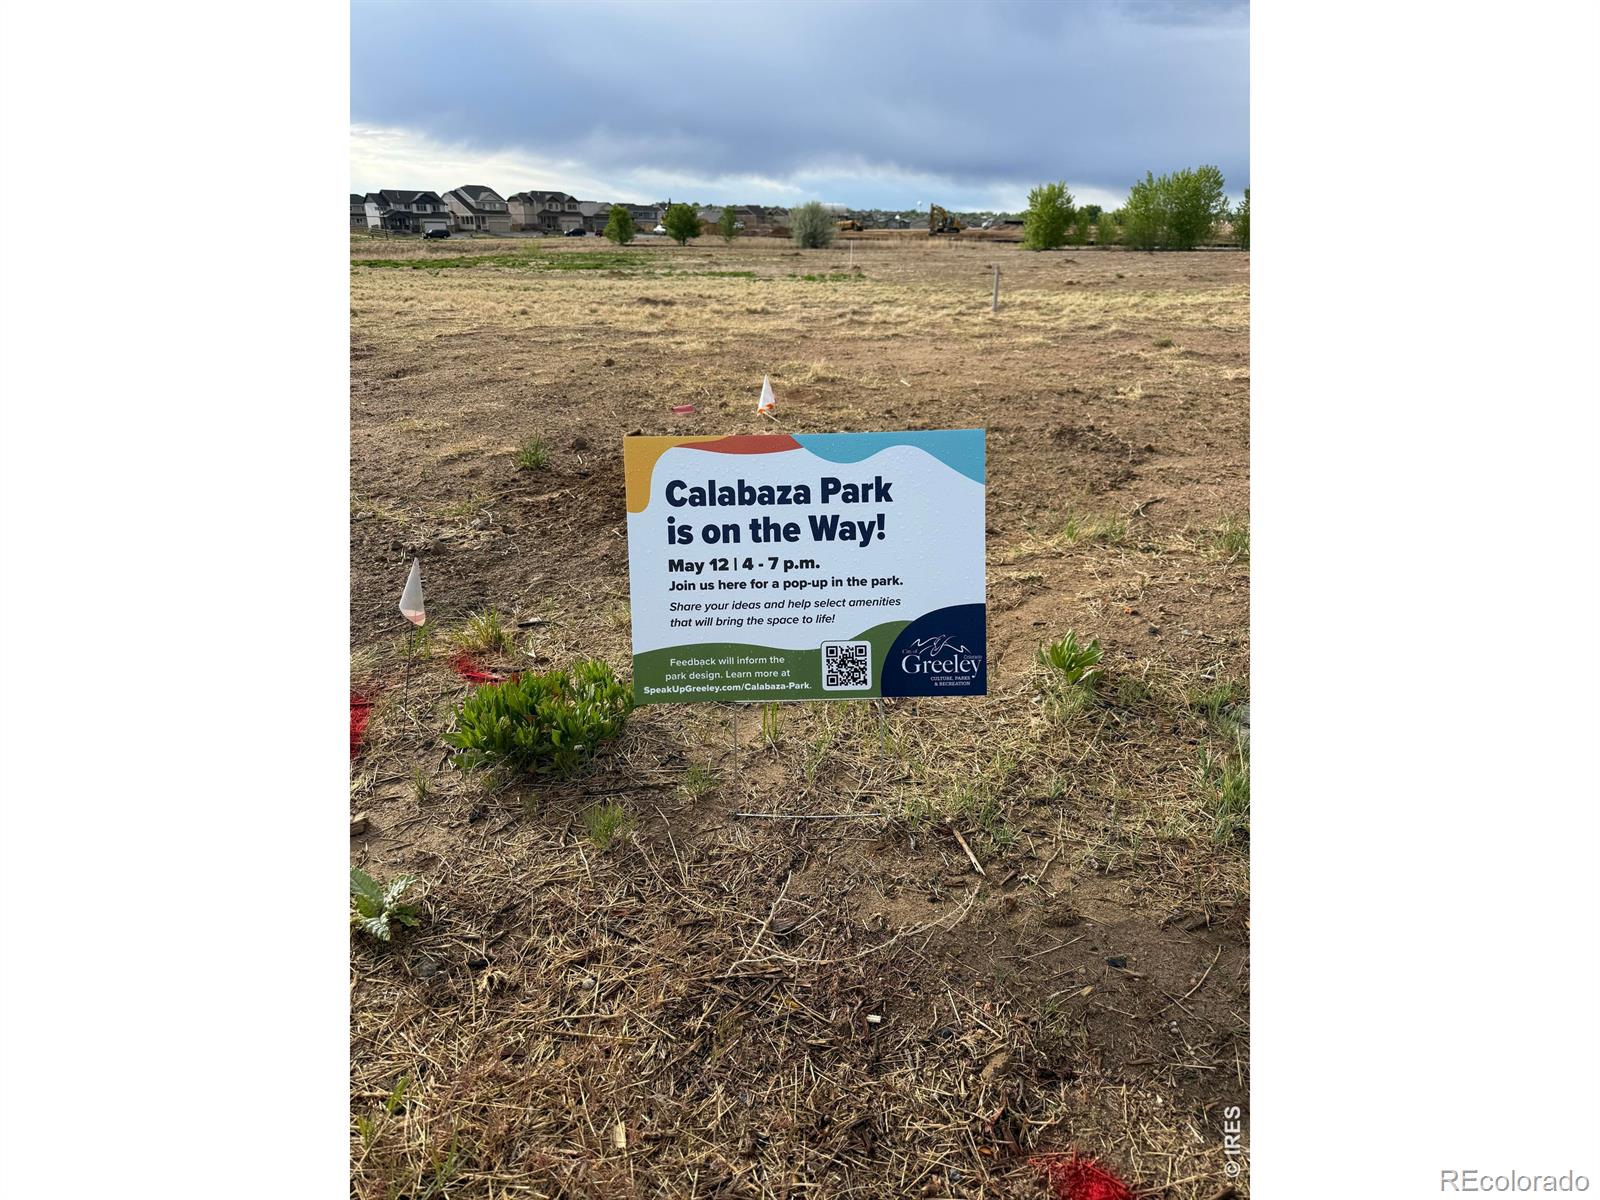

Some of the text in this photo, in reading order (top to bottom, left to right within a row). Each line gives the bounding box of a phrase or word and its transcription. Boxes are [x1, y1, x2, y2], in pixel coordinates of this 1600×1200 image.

[666, 476, 893, 506] Calabaza Park
[667, 513, 887, 547] is on the Way!
[668, 558, 704, 575] May
[709, 557, 729, 572] 12
[742, 557, 754, 571] 4
[768, 557, 779, 570] 7
[783, 557, 821, 573] p.m.
[669, 576, 904, 591] Join us here for a pop-up in the park.
[669, 596, 901, 613] Share your ideas and help select amenities
[670, 613, 835, 629] that will bring the space to life!
[670, 656, 785, 667] Feedback will inform the
[901, 654, 982, 678] Greeley
[665, 669, 791, 681] park design. Learn more at
[643, 682, 812, 694] SpeakUpGreeley.com/Calabaza-Park.
